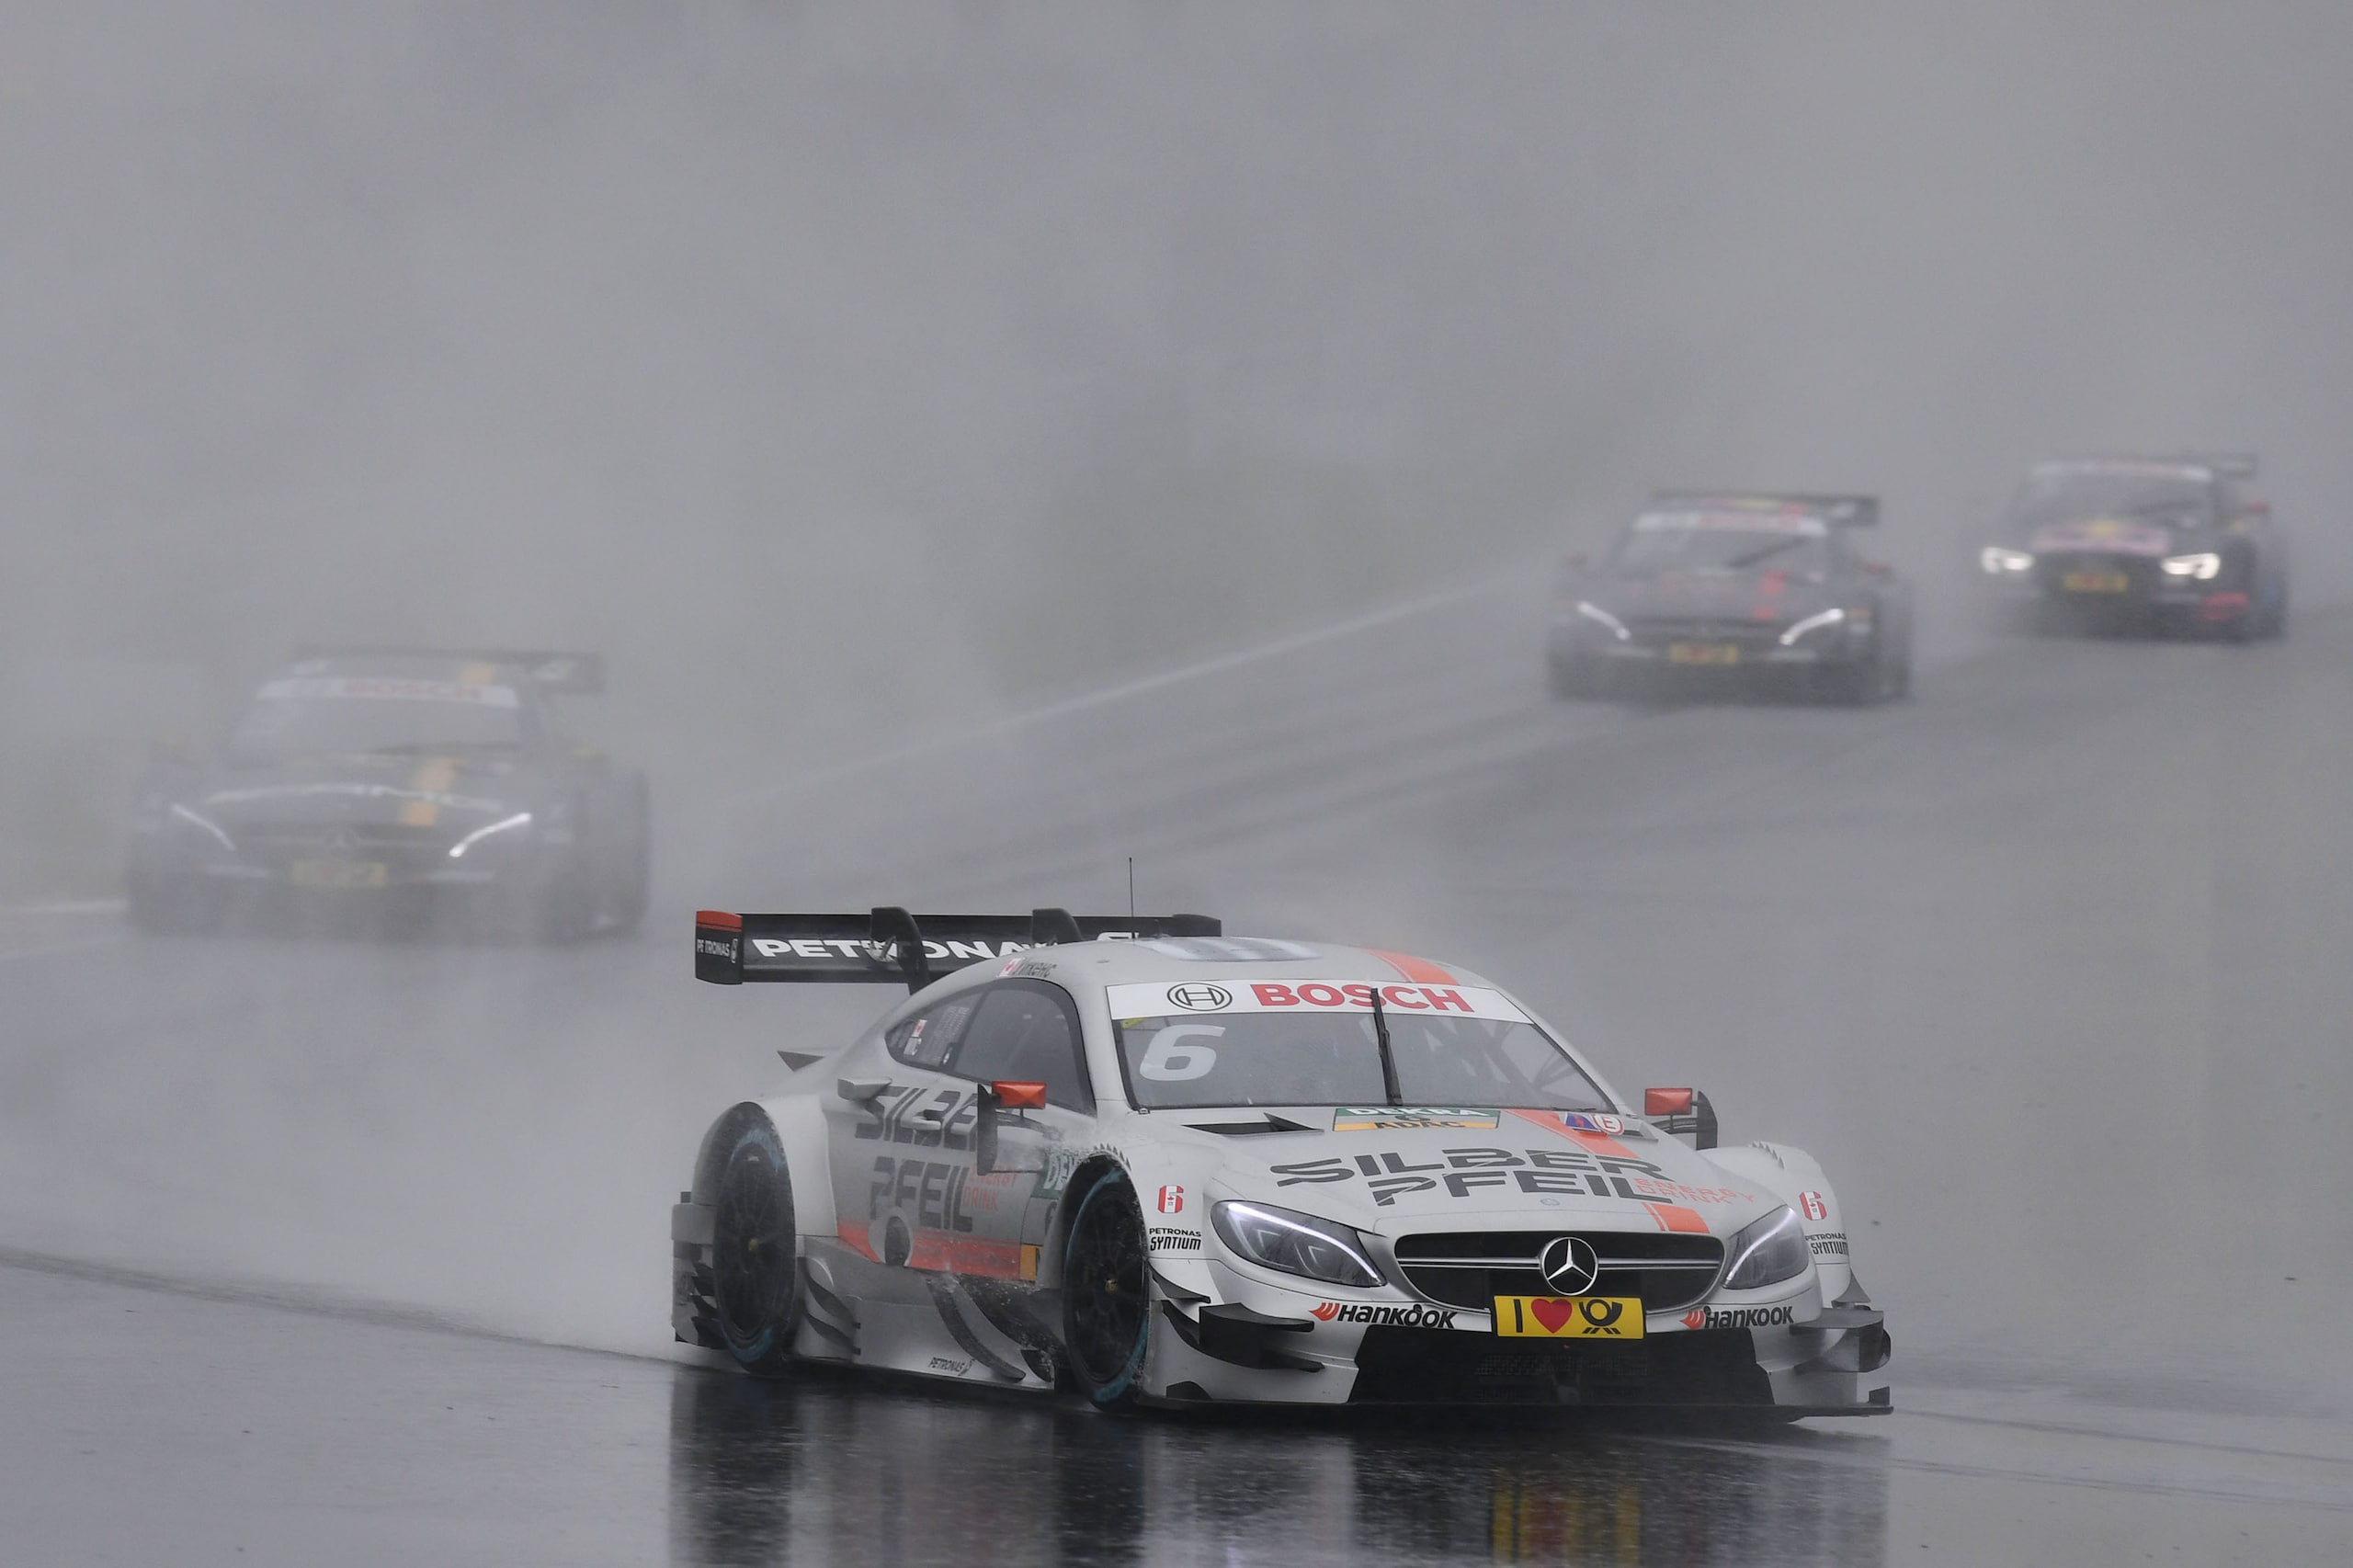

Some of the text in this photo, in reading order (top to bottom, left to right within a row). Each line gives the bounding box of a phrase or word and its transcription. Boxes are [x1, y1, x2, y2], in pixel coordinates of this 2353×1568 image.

[697, 938, 731, 957] PETRONAS
[752, 938, 1058, 960] PETONA
[1250, 983, 1475, 1013] BOSCH
[1139, 1024, 1226, 1082] 6
[854, 1085, 977, 1153] SILBE
[1346, 1108, 1491, 1117] DEKRA
[1269, 1148, 1676, 1187] SILBER
[870, 1155, 973, 1233] PFEIL
[1157, 1185, 1185, 1214] 6
[1368, 1170, 1674, 1207] PFEIL
[1799, 1190, 1827, 1221] 6
[1149, 1227, 1201, 1237] PETRONAS
[1150, 1236, 1202, 1251] SYNTIUM
[1513, 1299, 1524, 1334] I
